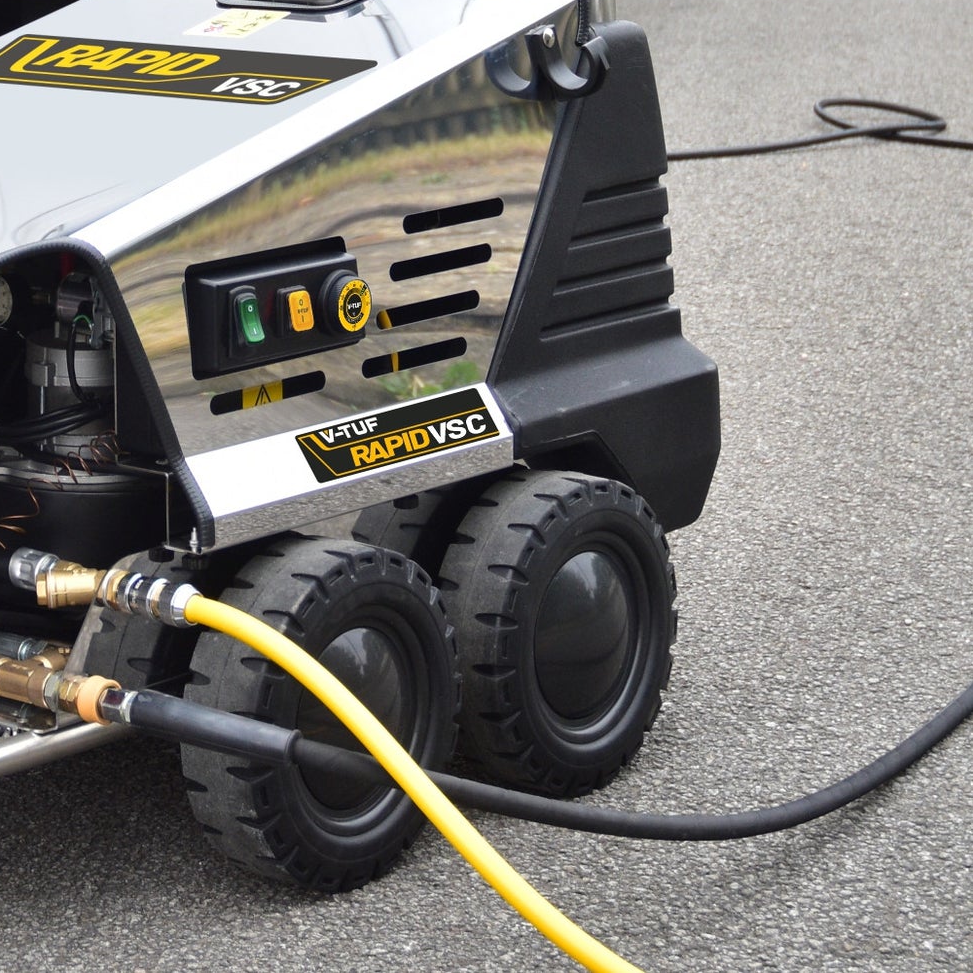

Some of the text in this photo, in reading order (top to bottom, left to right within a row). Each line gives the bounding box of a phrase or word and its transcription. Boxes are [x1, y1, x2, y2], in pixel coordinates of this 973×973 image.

[31, 44, 221, 76] RAPID
[211, 76, 301, 98] VSC
[318, 416, 378, 444] V-TUF
